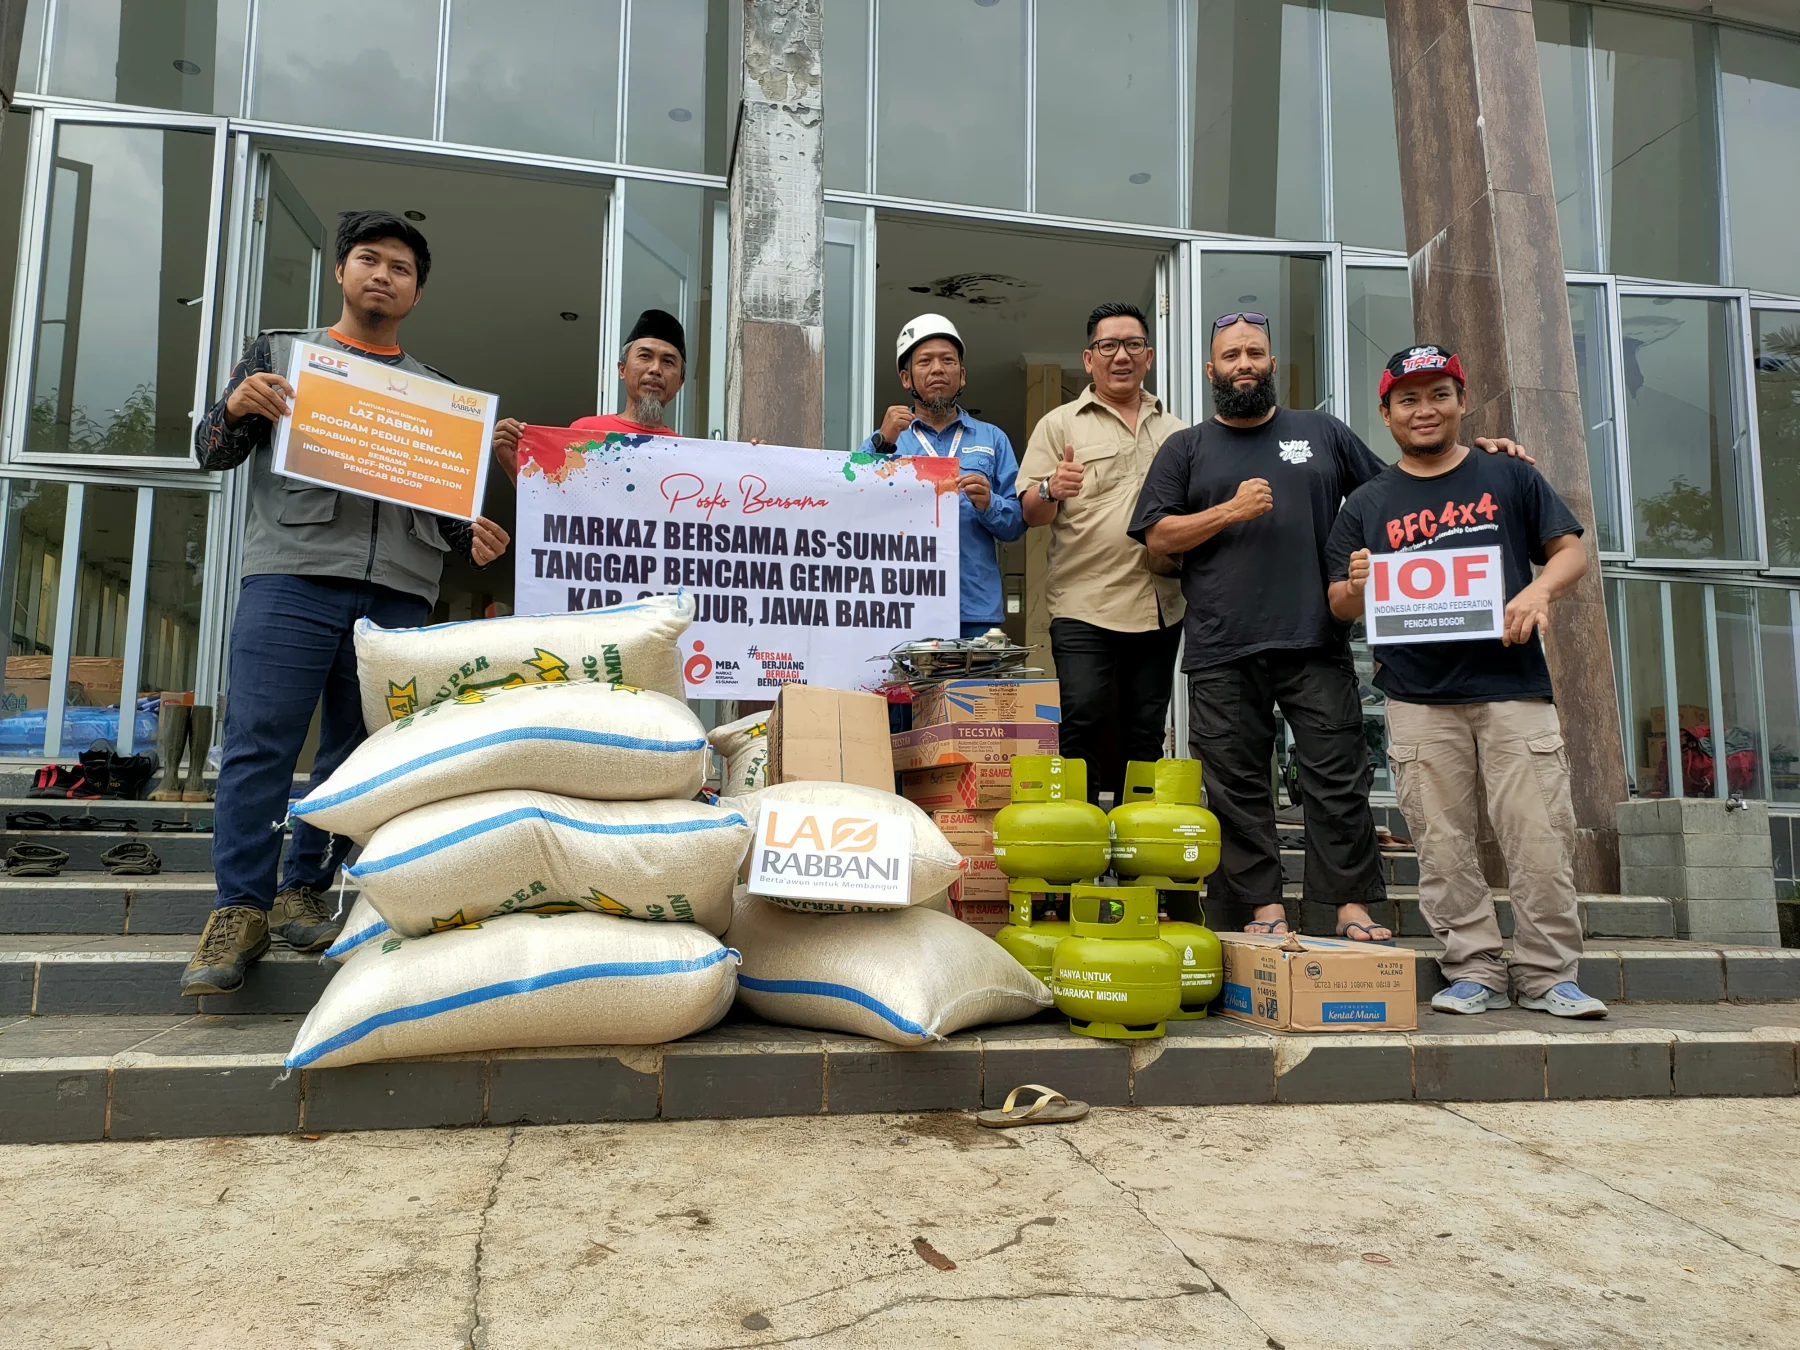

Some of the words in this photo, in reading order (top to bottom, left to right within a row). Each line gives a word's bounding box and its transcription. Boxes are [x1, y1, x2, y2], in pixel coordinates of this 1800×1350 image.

[309, 352, 349, 369] IOF
[1402, 356, 1447, 370] TAFT
[358, 400, 386, 412] BANTUAN
[451, 402, 481, 415] RABBANI
[348, 405, 374, 420] LAZ
[376, 413, 433, 437] RABBANI
[311, 411, 369, 434] PROGRAM
[371, 428, 410, 446] PEDULI
[412, 440, 463, 461] BENCANA
[298, 423, 357, 445] GEMPABUMI
[358, 439, 369, 448] DI
[370, 443, 411, 461] CIANJUR,
[413, 454, 440, 468] JAWA
[441, 462, 471, 476] BARAT
[302, 442, 355, 462] INDONESIA
[357, 457, 405, 475] OFF-ROAD
[406, 470, 463, 490] FEDERATION
[343, 463, 388, 480] PENGCAB
[389, 476, 423, 489] BOGOR
[660, 472, 730, 521] Posko
[739, 474, 829, 514] Bersama
[1464, 522, 1499, 534] Community
[543, 513, 657, 549] MARKAZ
[663, 520, 789, 556] BERSAMA
[793, 528, 937, 563] AS-SUNNAH
[531, 548, 657, 585] TANGGAP
[663, 556, 784, 590] BENCANA
[789, 563, 876, 595] GEMPA
[881, 567, 947, 597] BUMI
[1374, 554, 1489, 602] IOF
[759, 596, 829, 627] JAWA
[835, 600, 916, 630] BARAT
[1374, 604, 1411, 615] INDONESIA
[1412, 601, 1448, 613] OFF-ROAD
[1449, 599, 1493, 610] FEDERATION
[1404, 618, 1438, 629] PENGCAB
[1439, 616, 1465, 627] BOGOR
[715, 661, 740, 670] MBA
[761, 660, 805, 670] BERJUANG
[765, 669, 799, 679] BERBAGI
[958, 726, 1005, 737] TECSTAR
[988, 768, 1013, 778] SANEX
[950, 814, 978, 824] SANEX
[761, 850, 900, 881] RABBANI
[759, 875, 810, 886] Berta'awun
[813, 880, 839, 888] untuk
[842, 881, 898, 892] Membangun
[976, 904, 1005, 915] SANEX
[1059, 968, 1081, 980] HANYA
[1082, 971, 1112, 982] UNTUK
[1314, 981, 1331, 989] OCT23
[1096, 990, 1128, 1003] MISKIN
[1328, 1010, 1355, 1020] Kental
[1355, 1010, 1381, 1020] Manis
